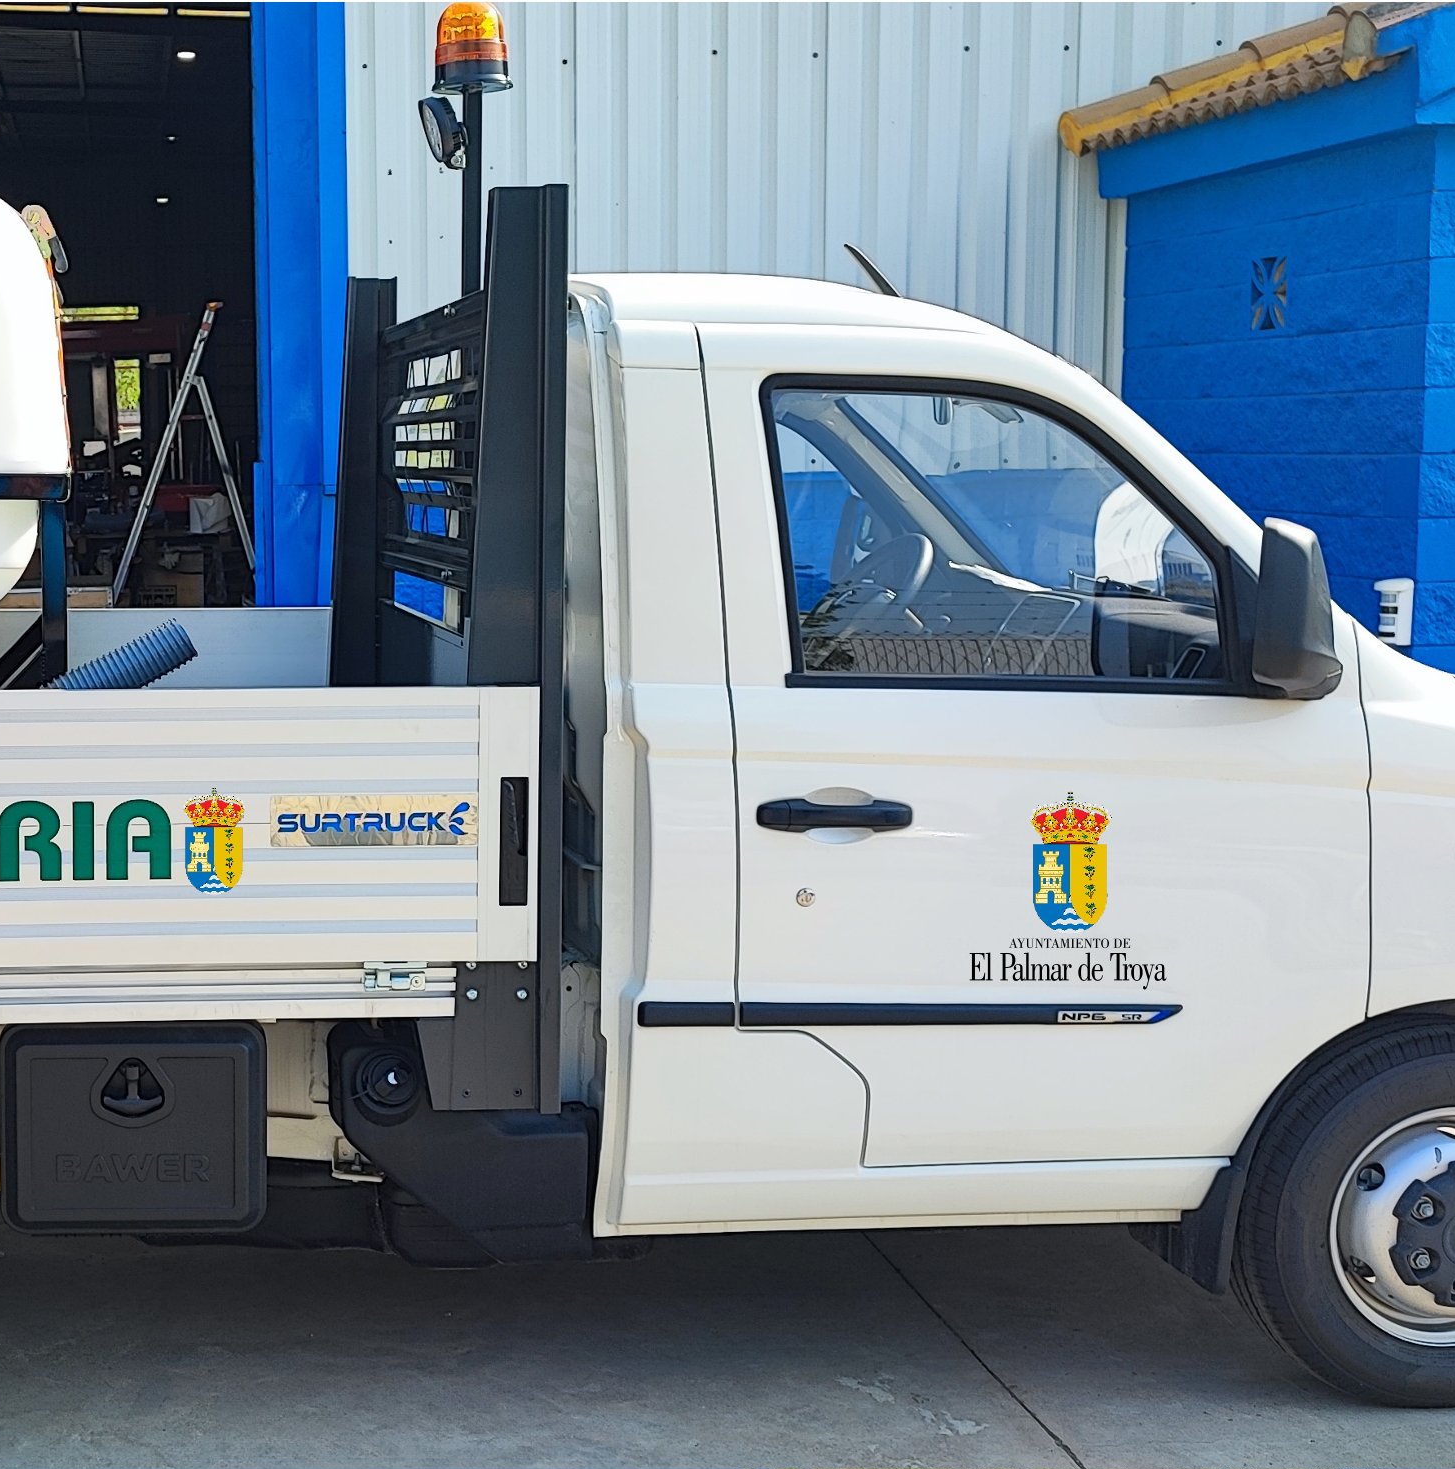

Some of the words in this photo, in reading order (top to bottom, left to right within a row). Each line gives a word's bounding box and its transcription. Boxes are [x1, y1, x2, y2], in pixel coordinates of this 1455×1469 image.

[277, 812, 446, 833] SURTRUCK
[1009, 938, 1110, 949] AYUNTAMIENTO
[1114, 938, 1131, 949] DE
[969, 952, 993, 981] El
[1000, 952, 1072, 981] Palmar
[1078, 952, 1104, 981] de
[1110, 952, 1167, 990] Troya
[1061, 1012, 1107, 1021] NP6
[1121, 1013, 1142, 1021] SR
[55, 1153, 210, 1183] BAWER
